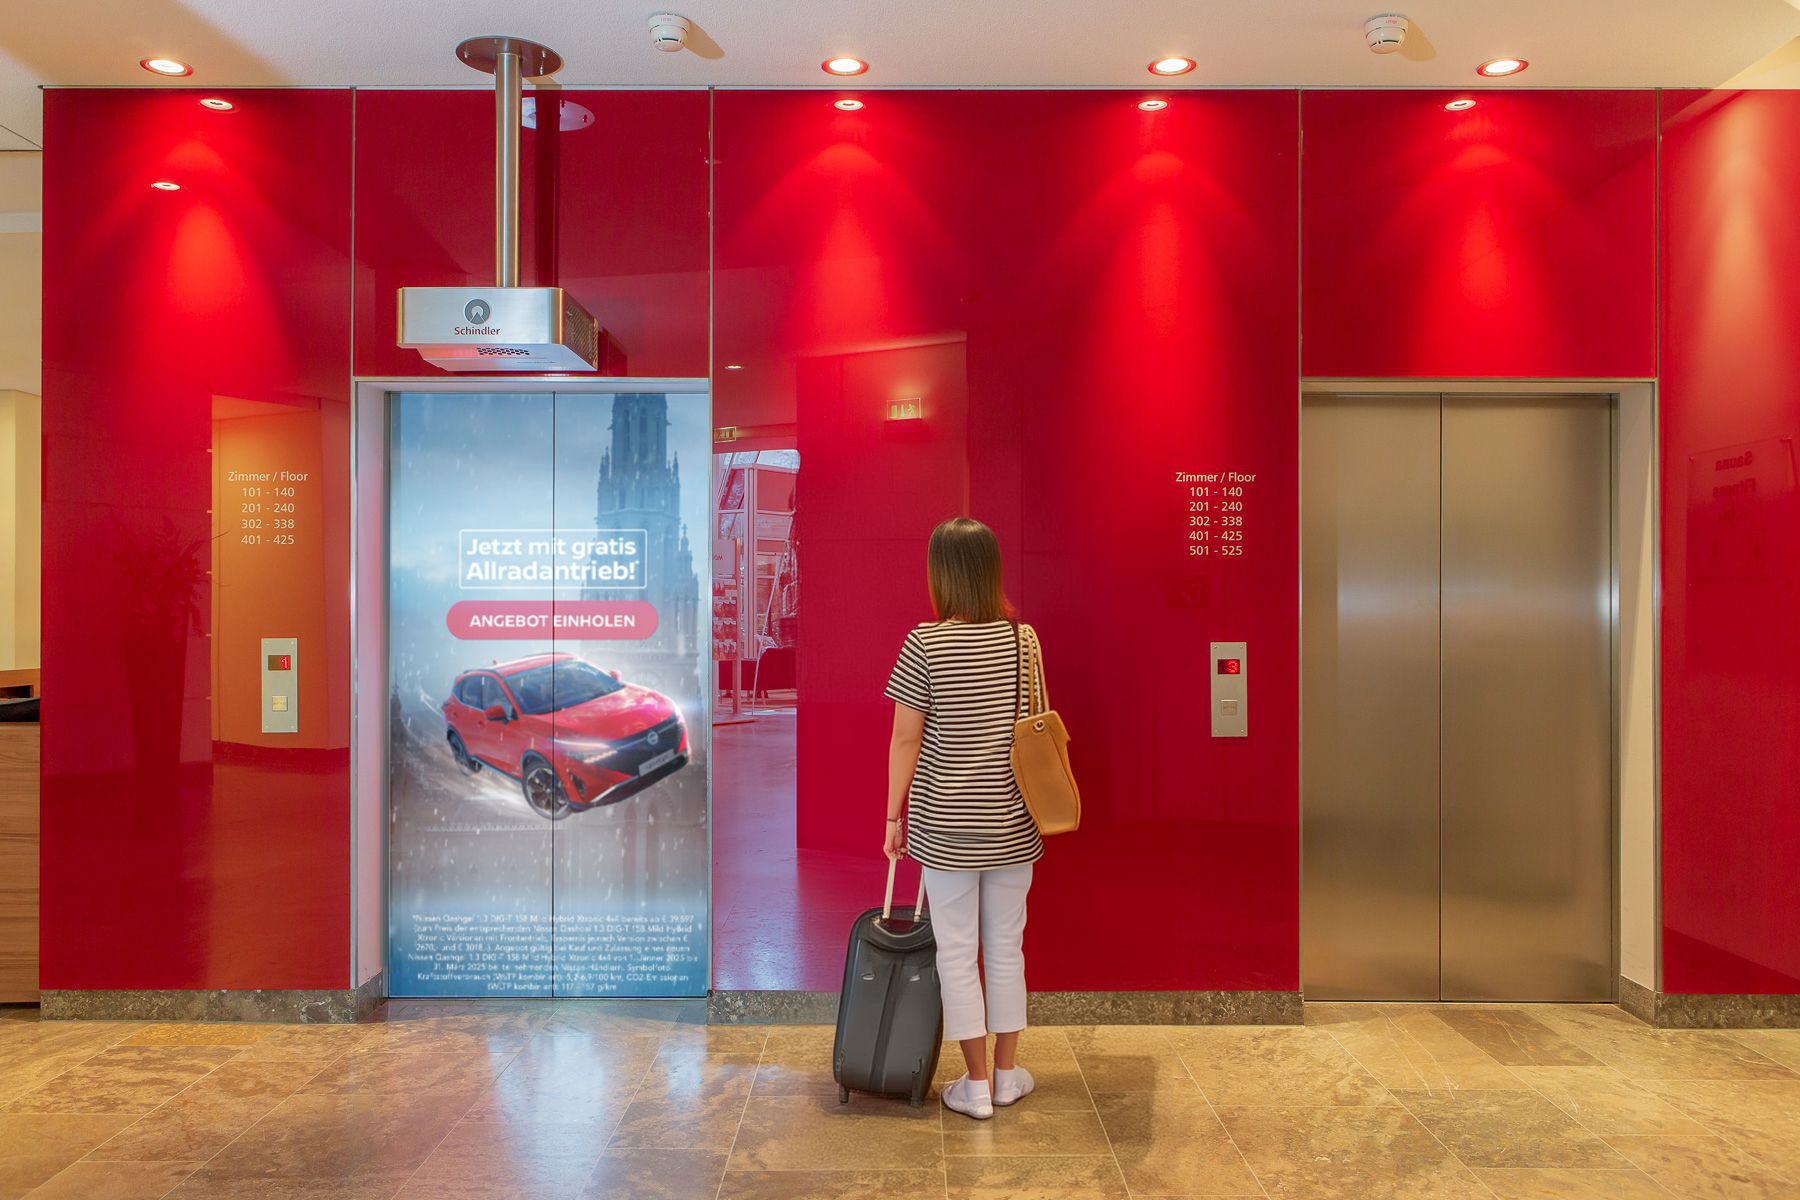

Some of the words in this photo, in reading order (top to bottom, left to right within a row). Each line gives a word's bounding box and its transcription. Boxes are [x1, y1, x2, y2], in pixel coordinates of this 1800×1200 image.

[454, 326, 501, 335] Schindler
[227, 471, 270, 482] Zimmer
[273, 471, 278, 483] /
[280, 471, 308, 482] Floor
[1175, 472, 1218, 483] Zimmer
[1220, 472, 1226, 483] /
[1228, 472, 1256, 483] Floor
[241, 487, 262, 497] 101
[273, 487, 295, 497] 140
[1189, 487, 1210, 497] 101
[1221, 487, 1243, 497] 140
[241, 502, 262, 513] 201
[273, 502, 295, 513] 240
[1189, 501, 1210, 512] 201
[1221, 501, 1243, 512] 240
[241, 518, 262, 529] 302
[273, 518, 295, 529] 338
[1189, 516, 1210, 527] 302
[1221, 516, 1243, 527] 338
[241, 534, 262, 545] 401
[273, 534, 295, 545] 425
[1189, 531, 1210, 542] 401
[1221, 531, 1243, 542] 425
[466, 538, 523, 556] Jetzt
[528, 538, 567, 556] mit
[571, 538, 637, 560] gratis
[1189, 545, 1210, 556] 501
[1221, 545, 1243, 556] 525
[469, 614, 549, 628] ANGEBOT
[553, 614, 636, 628] EINHOLEN
[281, 656, 288, 669] 1
[1228, 660, 1238, 673] 3
